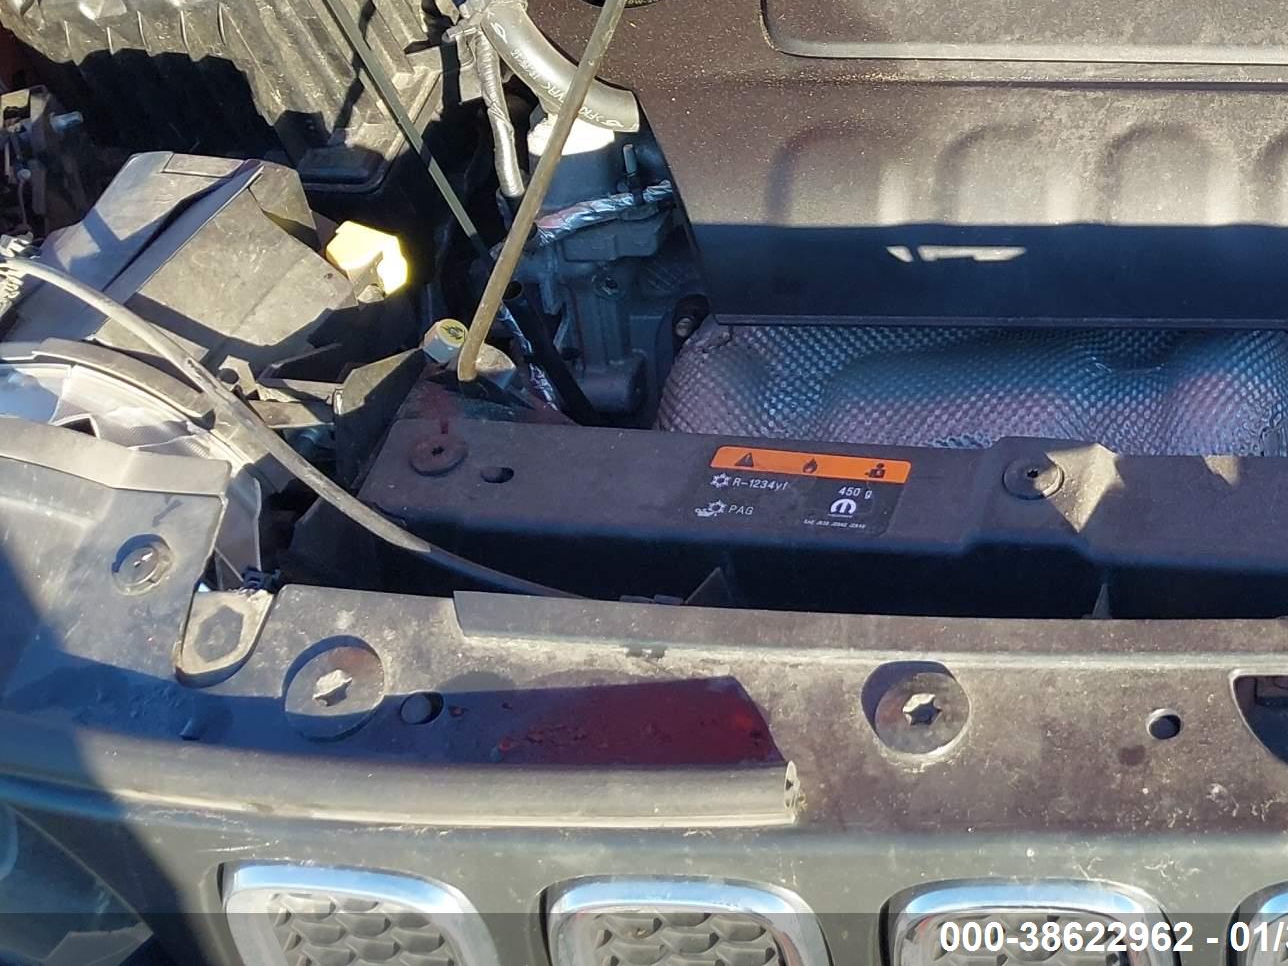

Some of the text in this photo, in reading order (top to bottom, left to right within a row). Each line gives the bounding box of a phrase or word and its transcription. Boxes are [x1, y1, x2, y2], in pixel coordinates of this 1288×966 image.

[732, 476, 873, 500] R-1234yf 450 g
[728, 504, 755, 516] PAG
